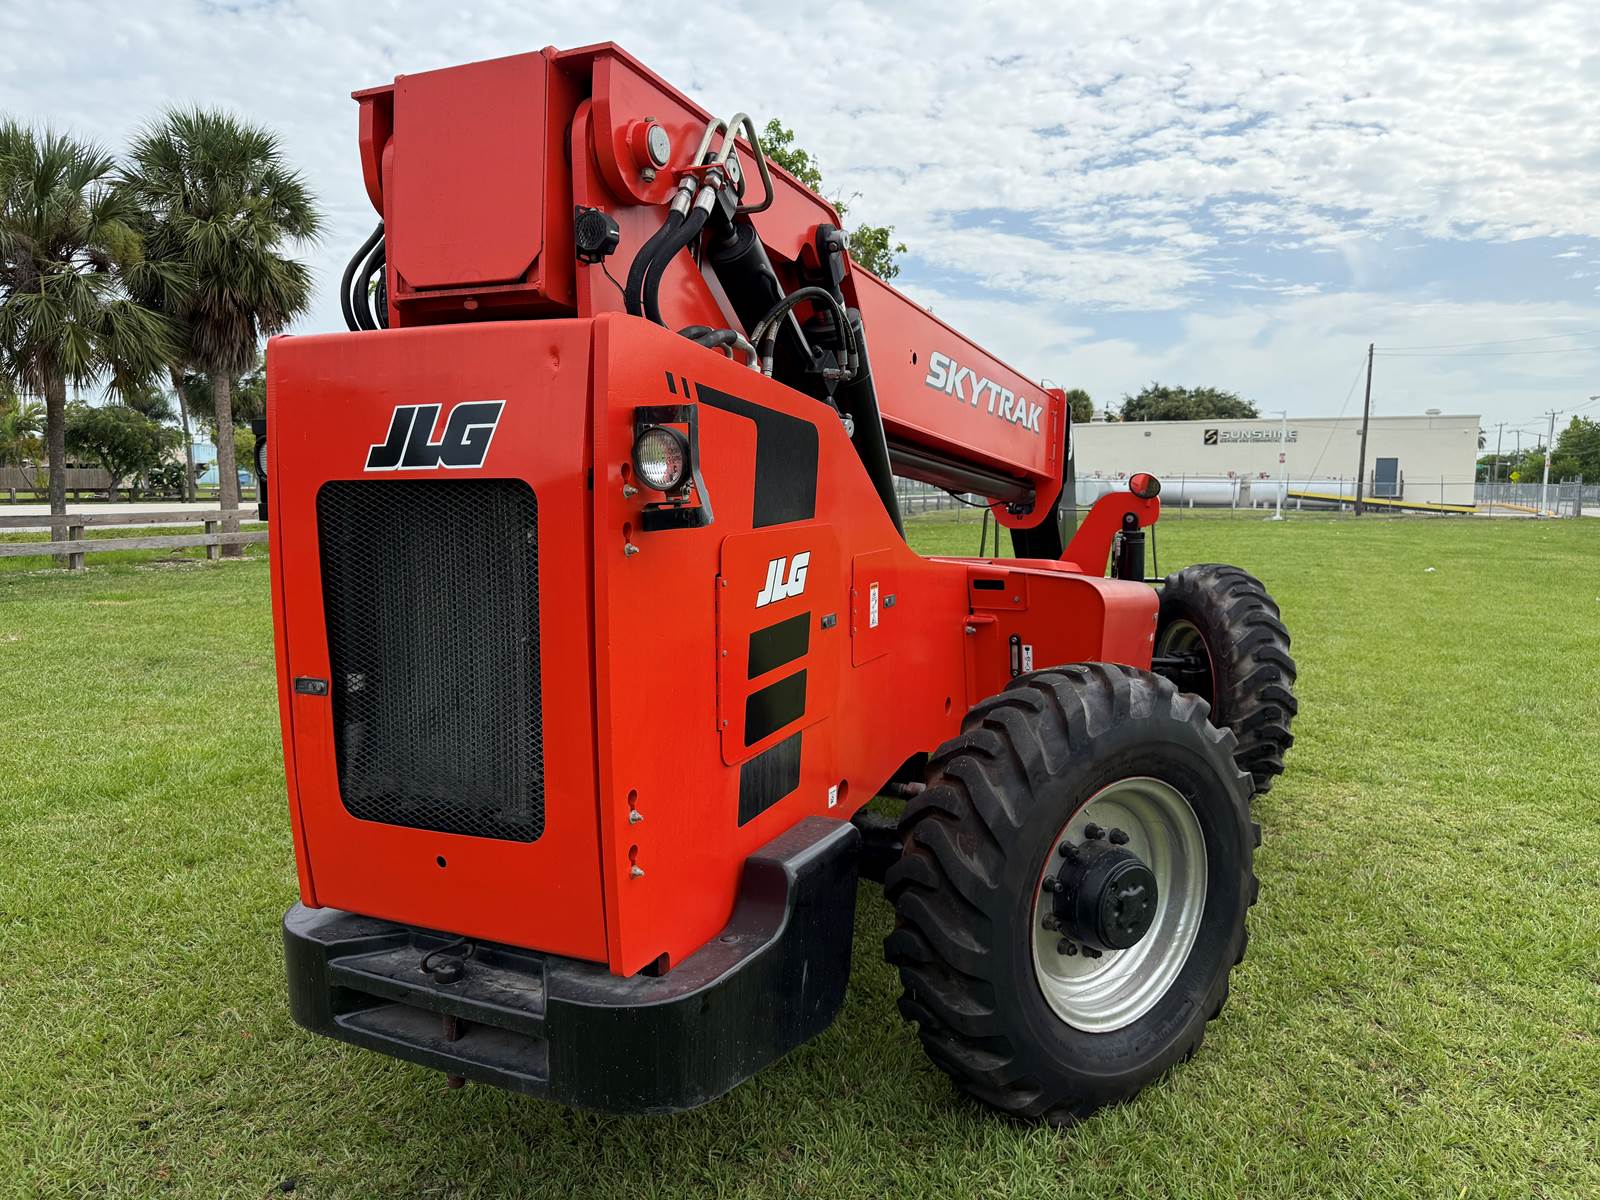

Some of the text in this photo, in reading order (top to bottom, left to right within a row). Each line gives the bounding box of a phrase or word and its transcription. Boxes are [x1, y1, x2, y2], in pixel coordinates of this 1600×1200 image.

[925, 351, 1044, 433] SKYTRAK
[363, 400, 507, 471] JLG
[755, 550, 811, 608] JLG
